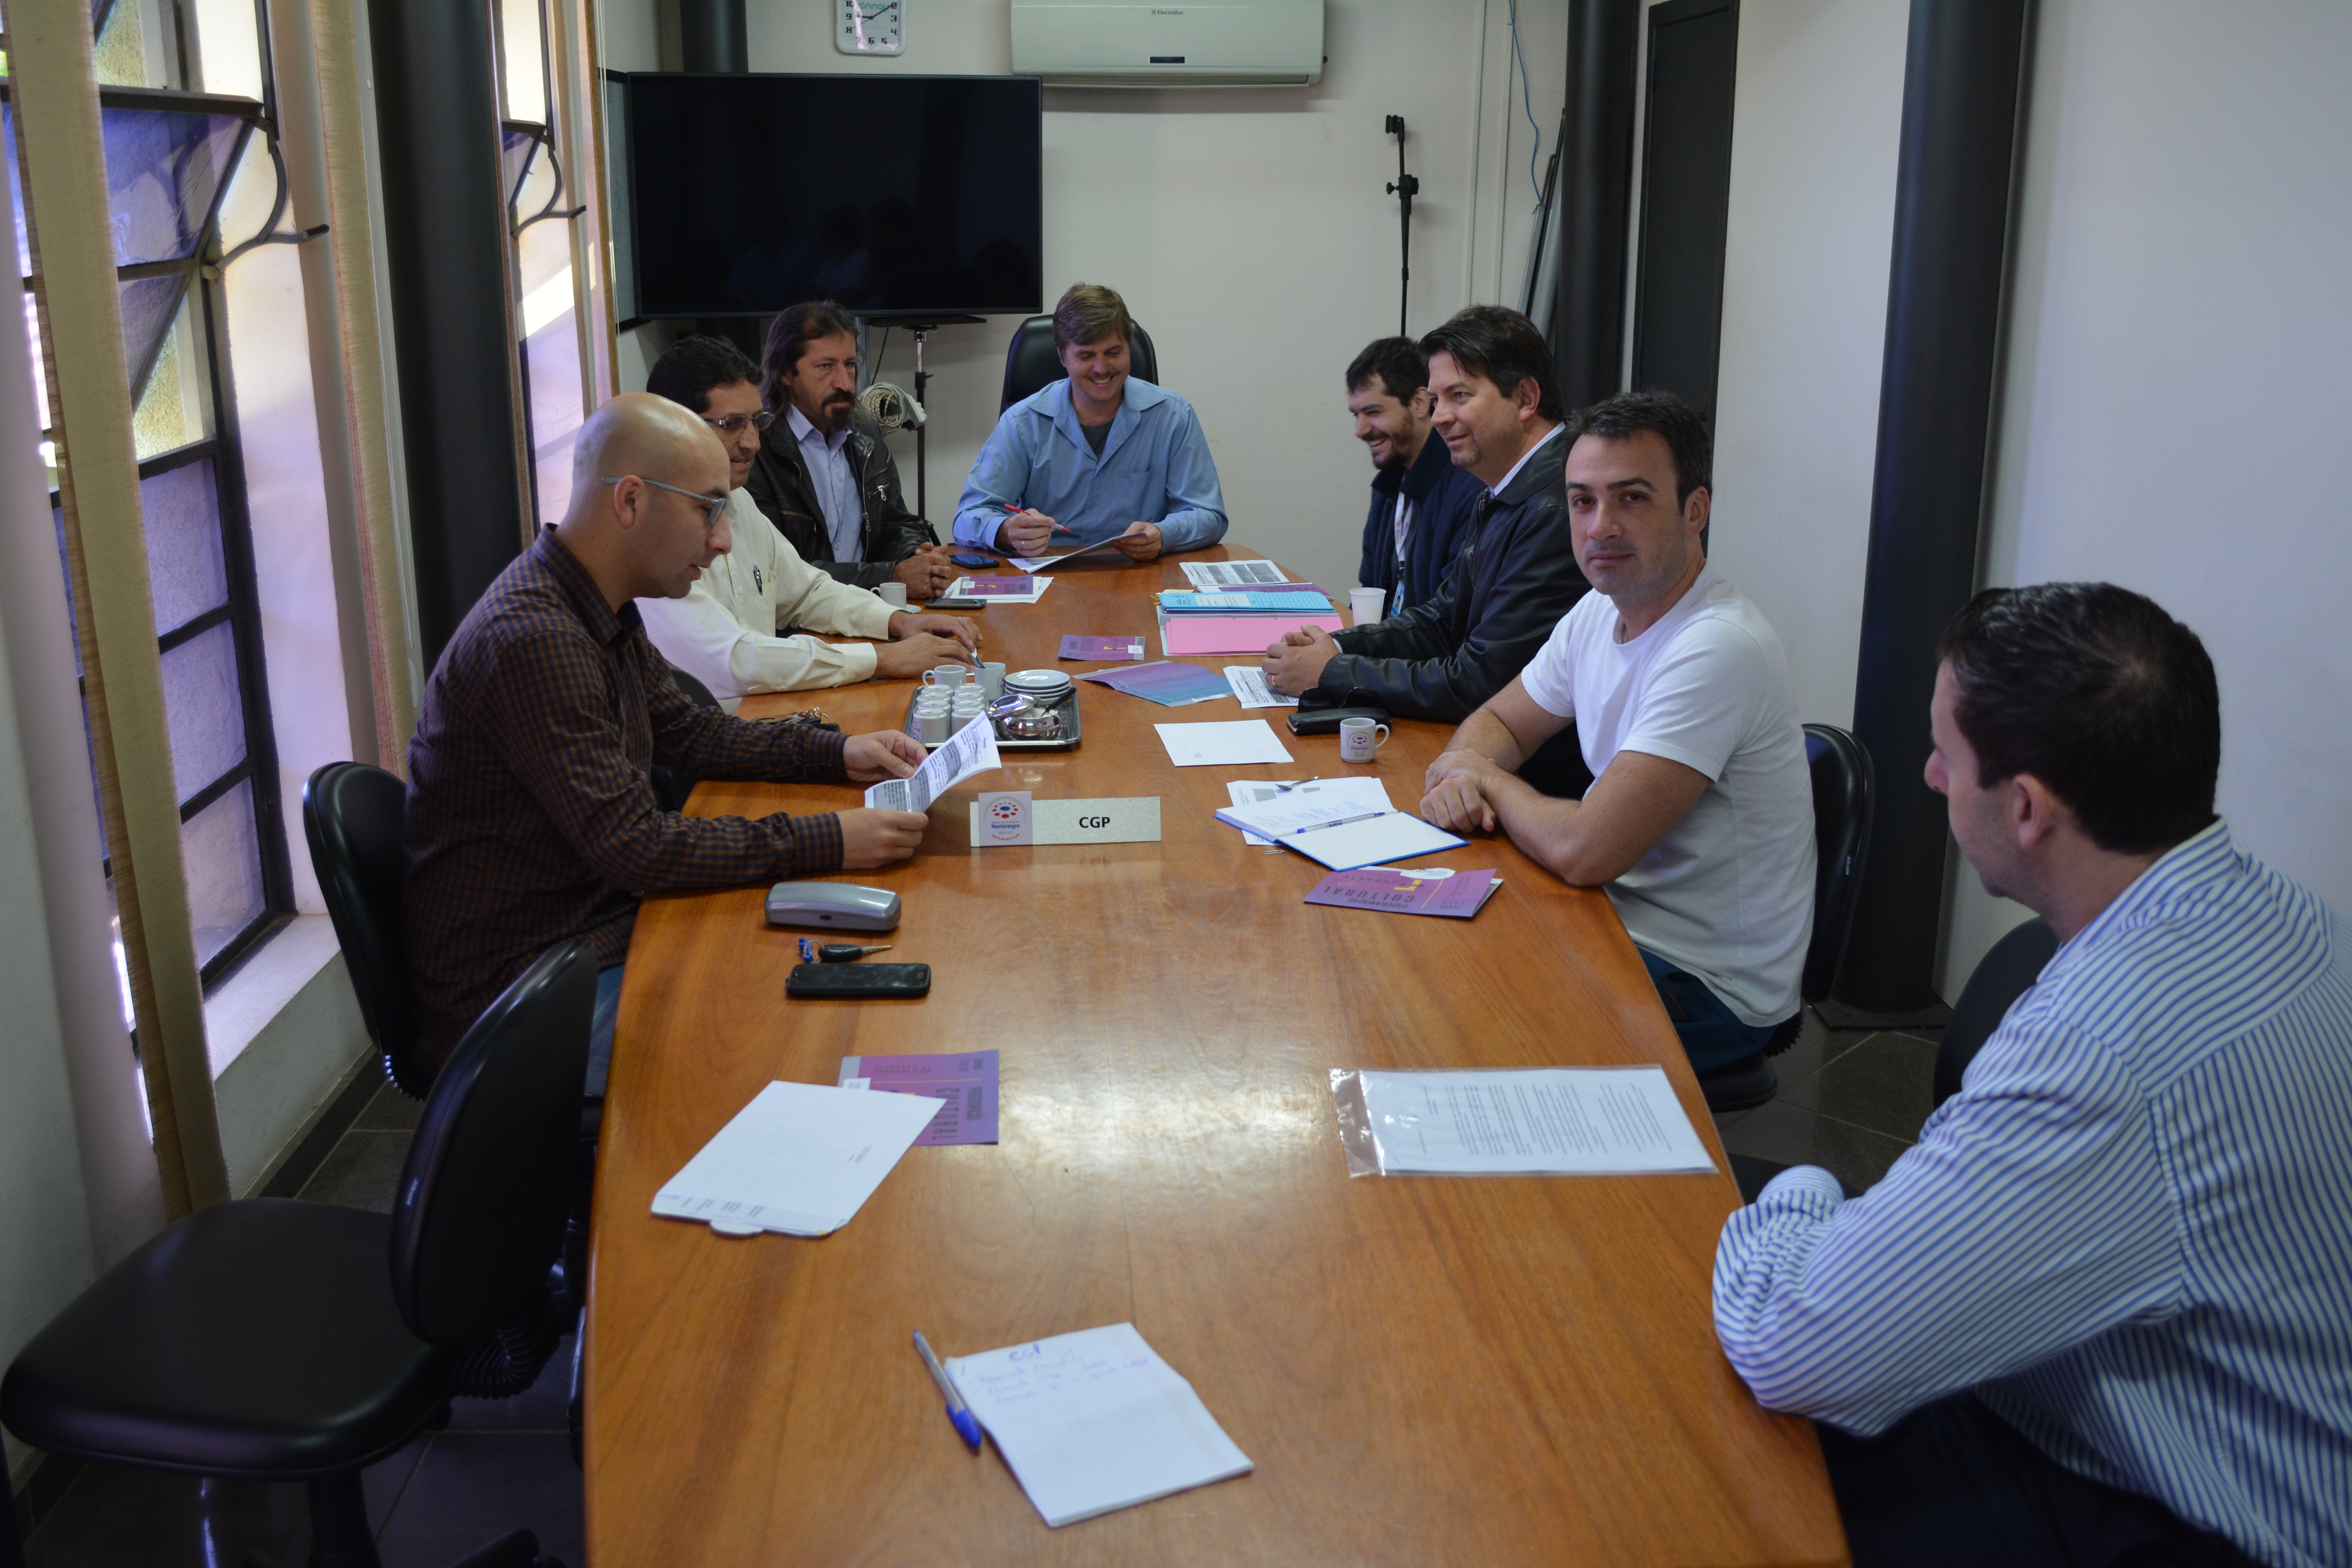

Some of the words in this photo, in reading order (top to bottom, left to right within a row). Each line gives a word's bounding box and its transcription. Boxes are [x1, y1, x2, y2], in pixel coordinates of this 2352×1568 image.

[1079, 817, 1111, 828] CGP
[1344, 875, 1405, 886] FUNDARTE
[1324, 886, 1415, 903] CULTURAL
